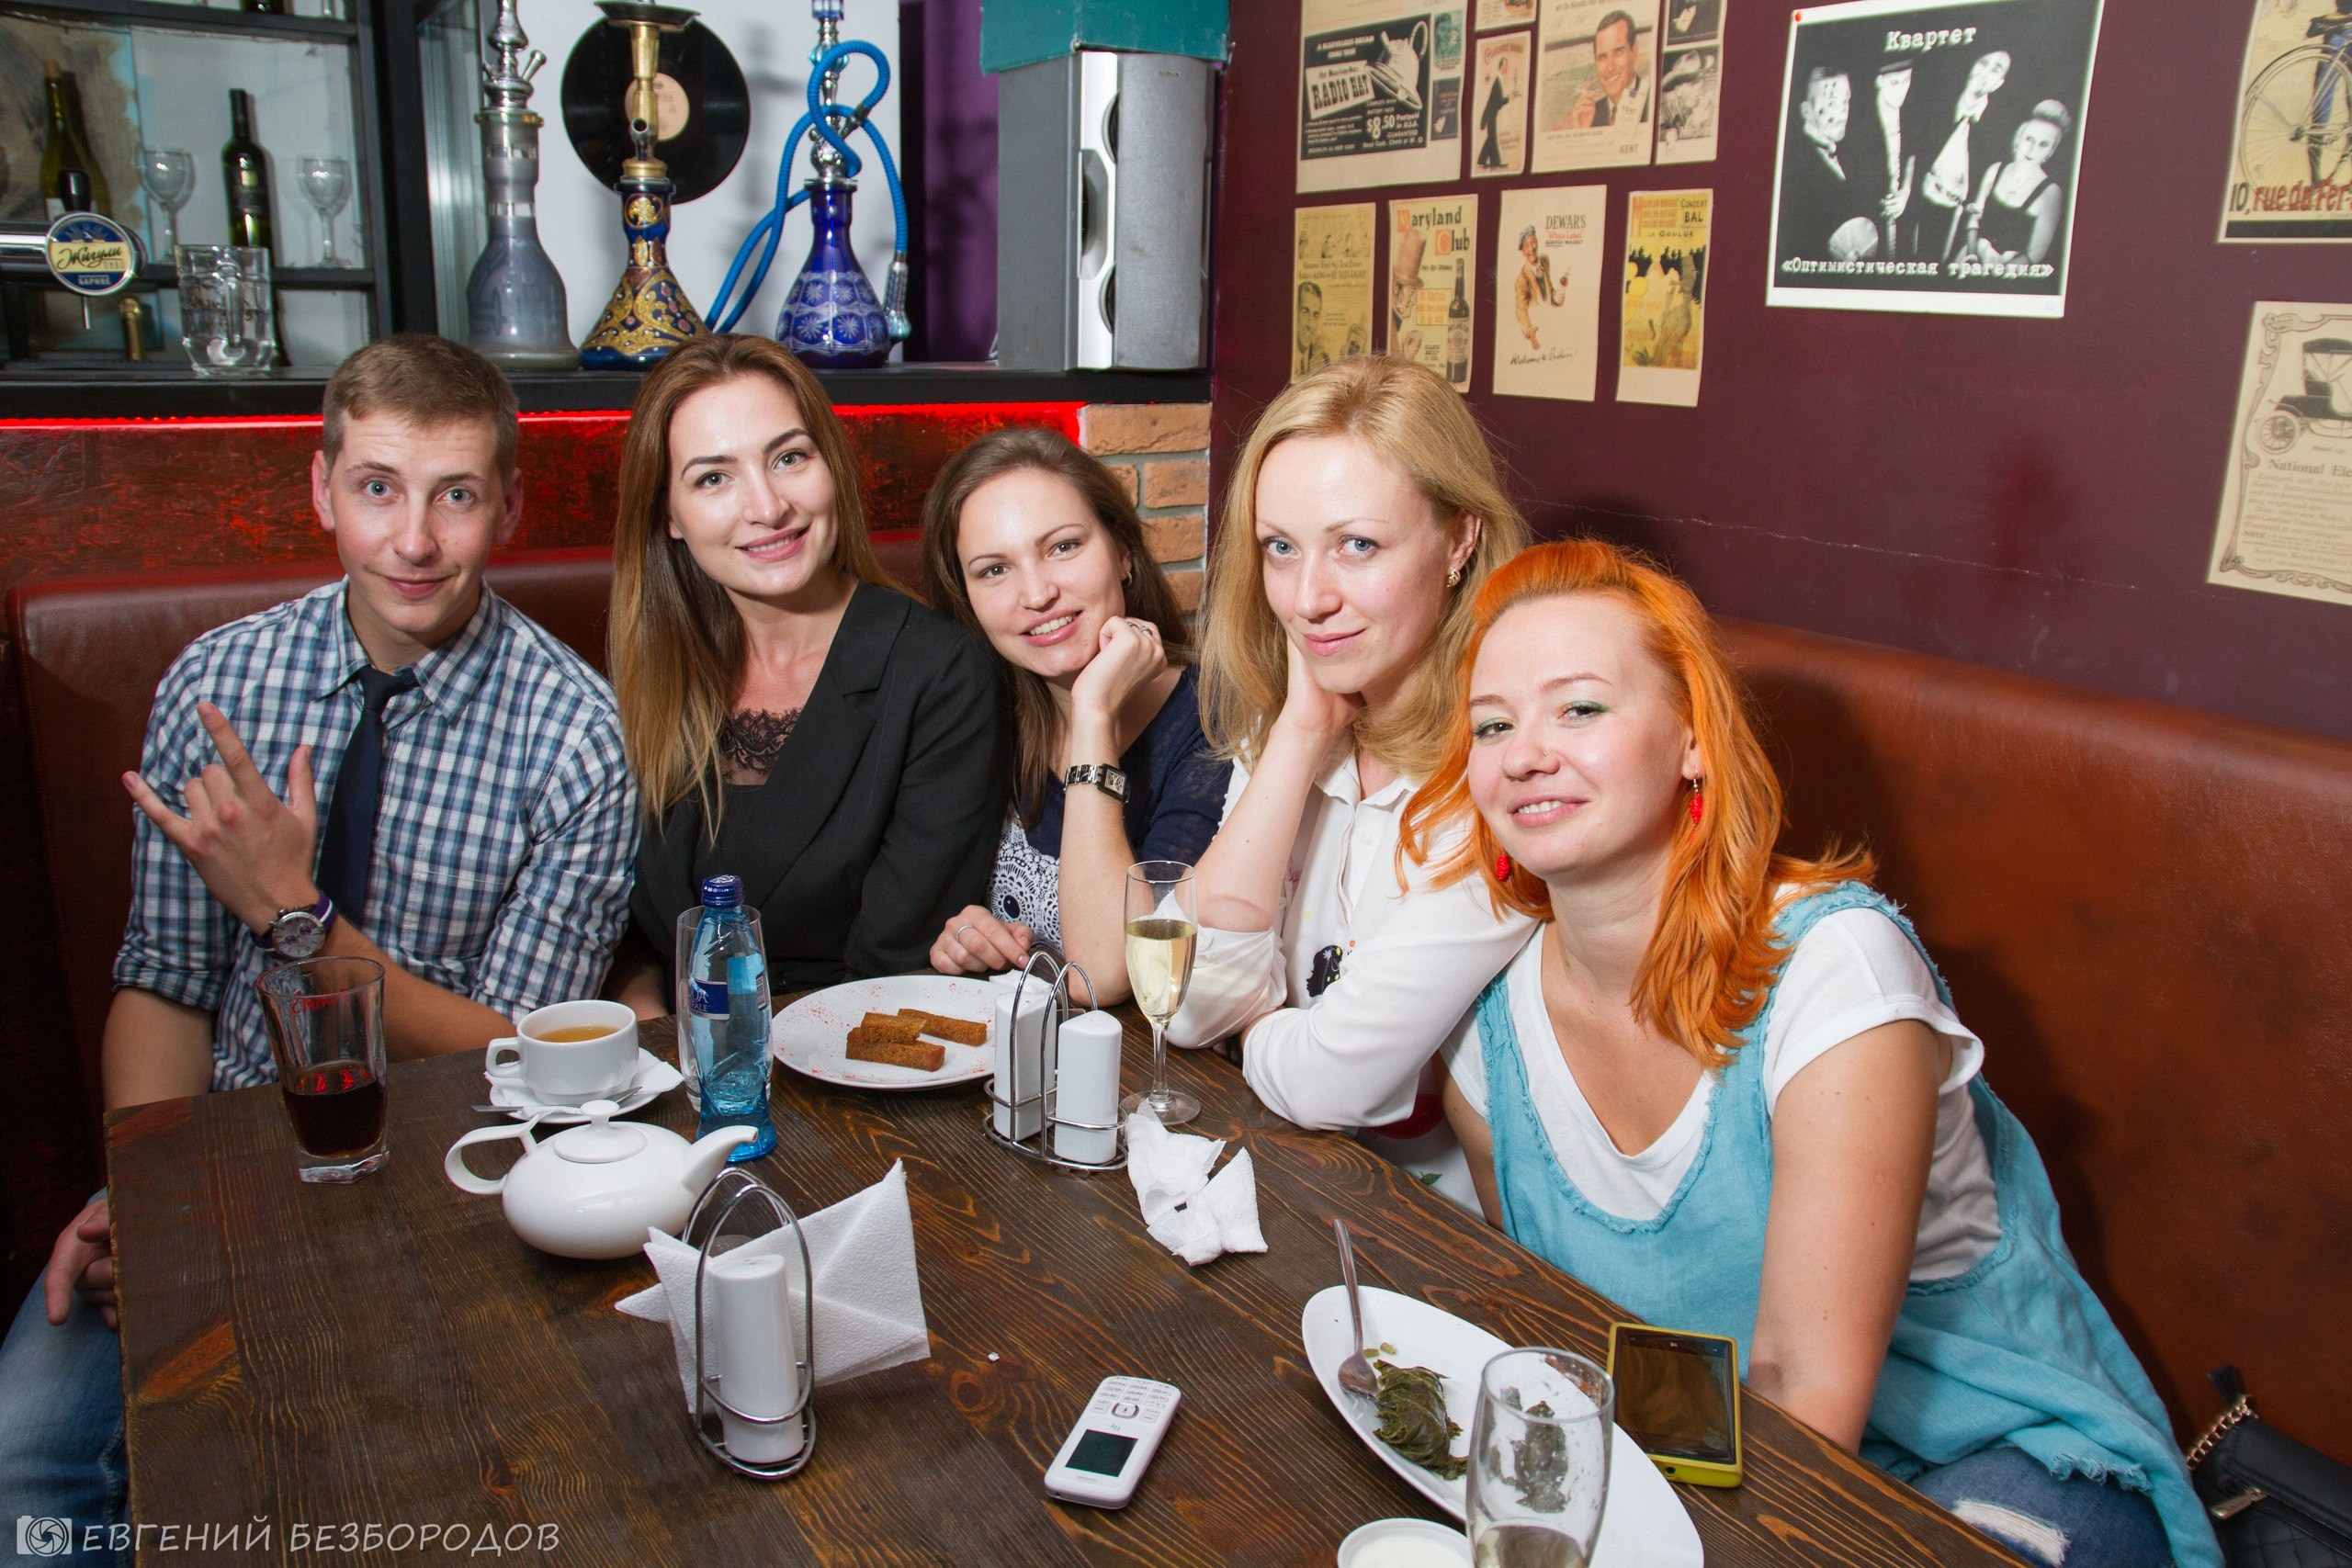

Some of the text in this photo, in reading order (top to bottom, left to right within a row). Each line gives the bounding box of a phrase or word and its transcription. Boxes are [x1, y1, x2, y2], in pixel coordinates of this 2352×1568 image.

[1883, 27, 1977, 52] Квартет
[1311, 73, 1370, 110] RADIO HAT
[1619, 143, 1639, 154] KENT
[1680, 198, 1707, 208] CONCERT
[2230, 181, 2250, 216] 10,
[2252, 185, 2287, 212] rue
[1396, 206, 1463, 231] Maryland
[1545, 214, 1587, 230] DEWAR'S
[1684, 211, 1703, 222] BAL
[1434, 228, 1470, 255] Club
[1548, 230, 1582, 239] White Label
[56, 246, 122, 270] Жигули
[1781, 256, 2055, 280] «Оптимистическая трагедия»
[2269, 458, 2325, 475] National
